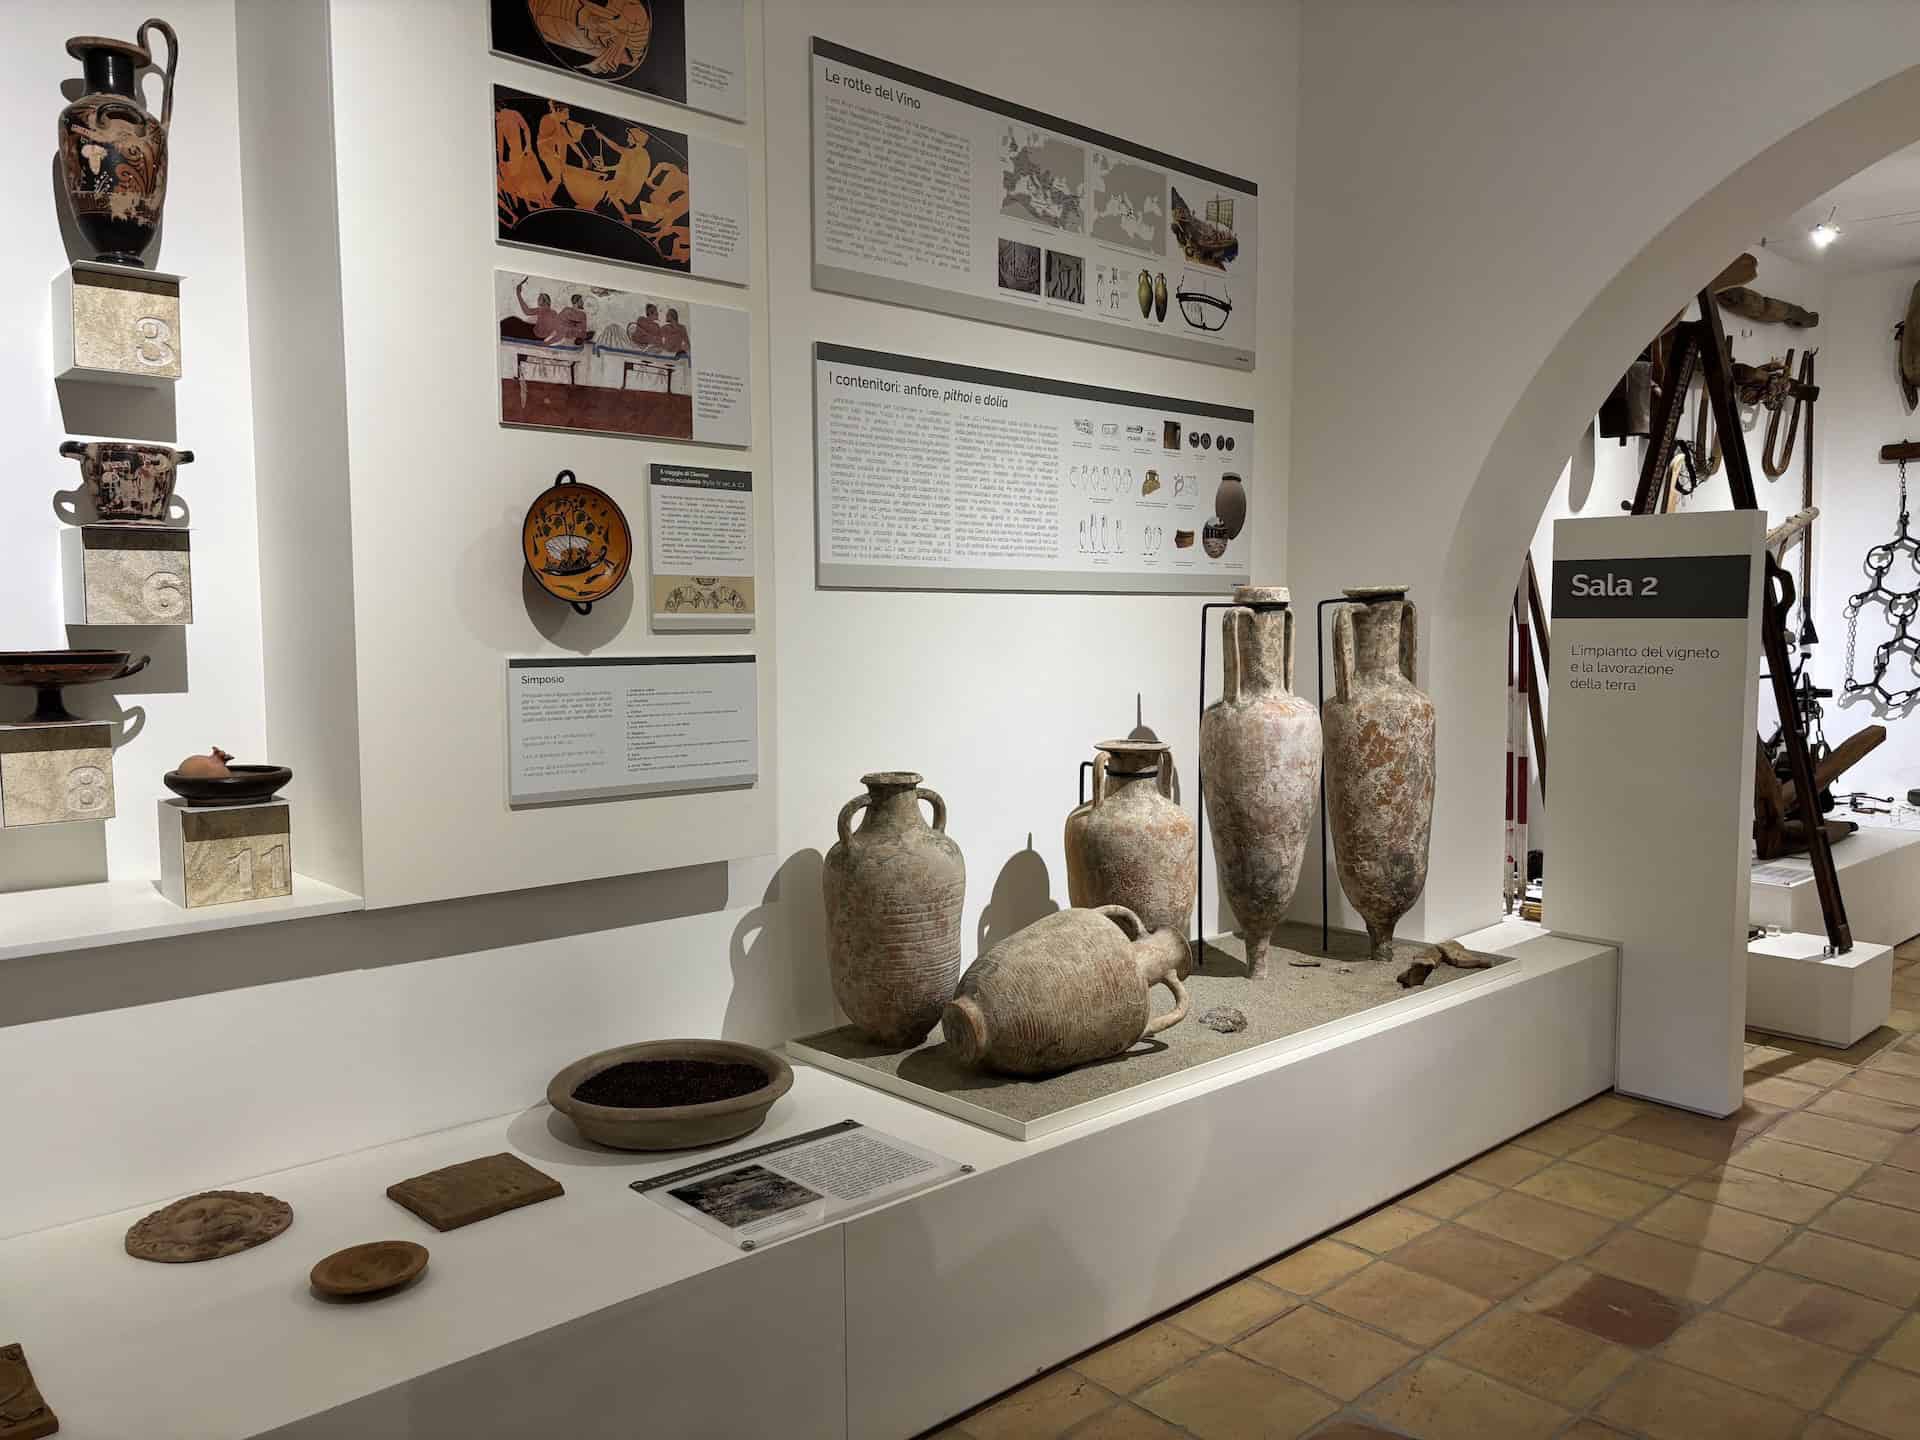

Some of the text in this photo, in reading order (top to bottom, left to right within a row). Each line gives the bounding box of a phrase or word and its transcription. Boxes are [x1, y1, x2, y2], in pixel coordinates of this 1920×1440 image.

[825, 66, 921, 109] Le rotte del Vino
[135, 315, 177, 367] 3
[835, 375, 901, 393] contenitori:
[903, 383, 941, 400] anfore,
[943, 388, 973, 403] pithoi
[975, 395, 981, 405] e
[983, 394, 1008, 408] dolia
[143, 571, 184, 617] 6
[1571, 573, 1659, 597] Sala 2
[1570, 661, 1674, 675] e la lavorazione
[1571, 644, 1720, 661] L'impianto del vigneto
[521, 675, 565, 688] Simposio
[1570, 678, 1637, 692] della terra
[67, 766, 107, 812] 8
[225, 844, 287, 889] 11
